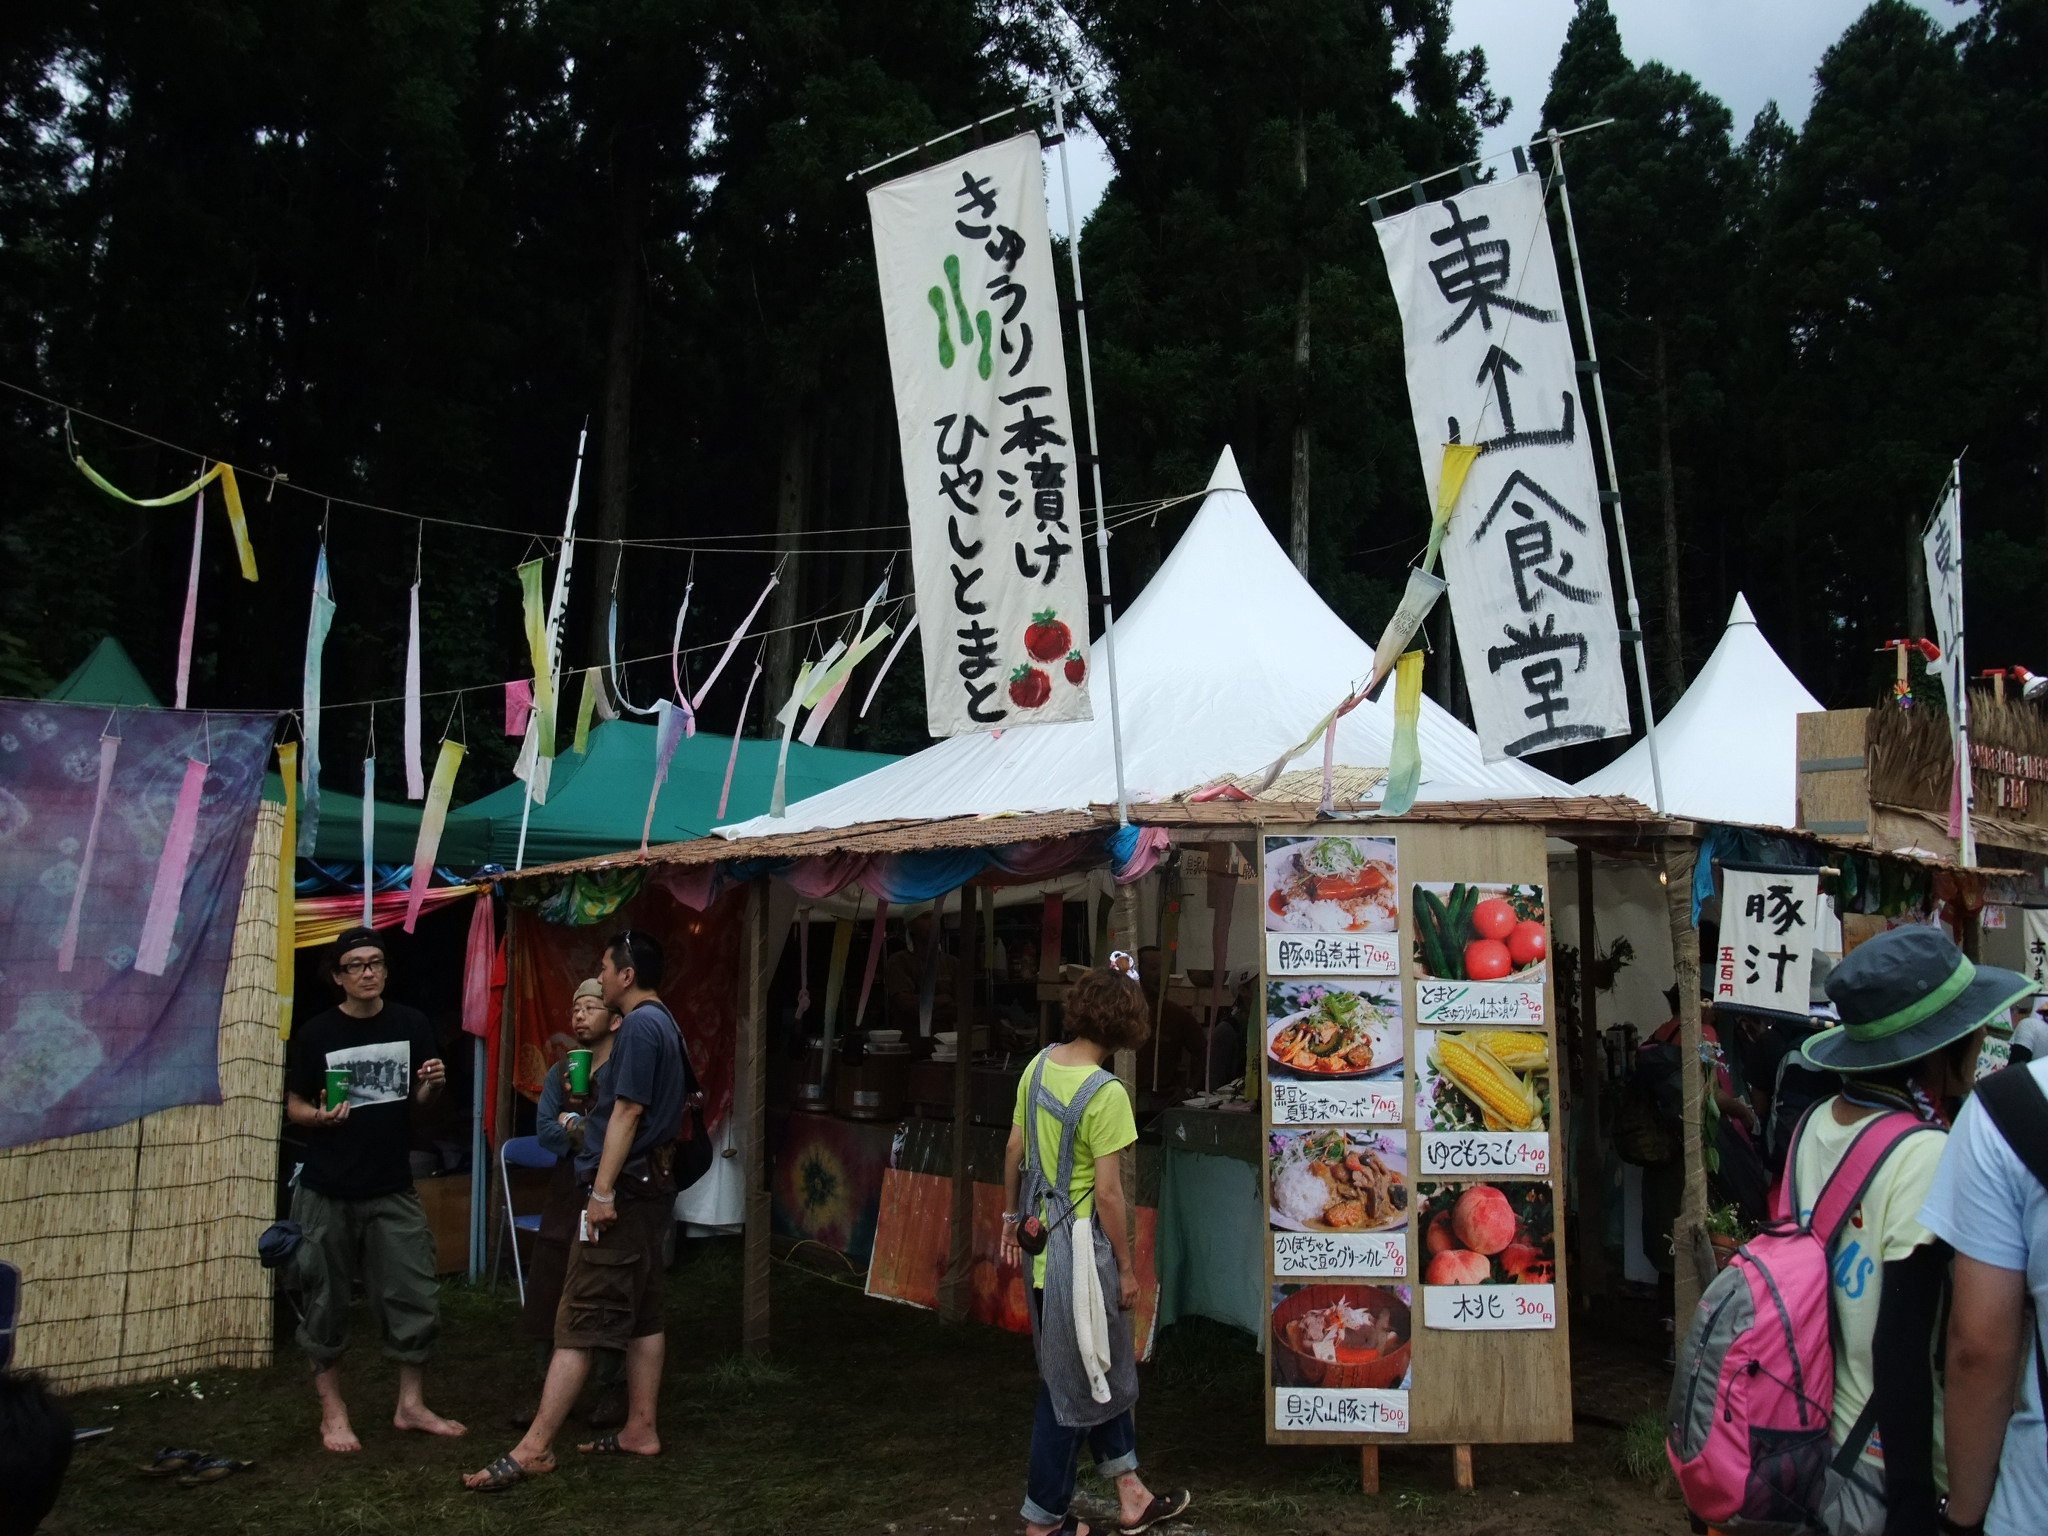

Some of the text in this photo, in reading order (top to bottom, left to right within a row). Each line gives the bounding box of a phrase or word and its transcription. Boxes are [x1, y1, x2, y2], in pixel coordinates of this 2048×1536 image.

[1428, 199, 1605, 757] 東山食堂
[934, 413, 1008, 723] ひやしとまと
[1278, 938, 1361, 970] 豚の角煮丼
[1744, 884, 1807, 994] 豚汁
[1719, 945, 1735, 997] 五百円
[1273, 1084, 1308, 1107] 黒豆と
[1284, 1097, 1371, 1123] 夏野菜のマーボー
[1427, 1138, 1517, 1170] ゆでもろこし
[1276, 1235, 1335, 1255] かぼちゃと
[1282, 1245, 1389, 1271] ひよこ豆のグリーンカレー
[1452, 1292, 1505, 1324] 桃
[1284, 1394, 1381, 1427] 具沢山豚汁
